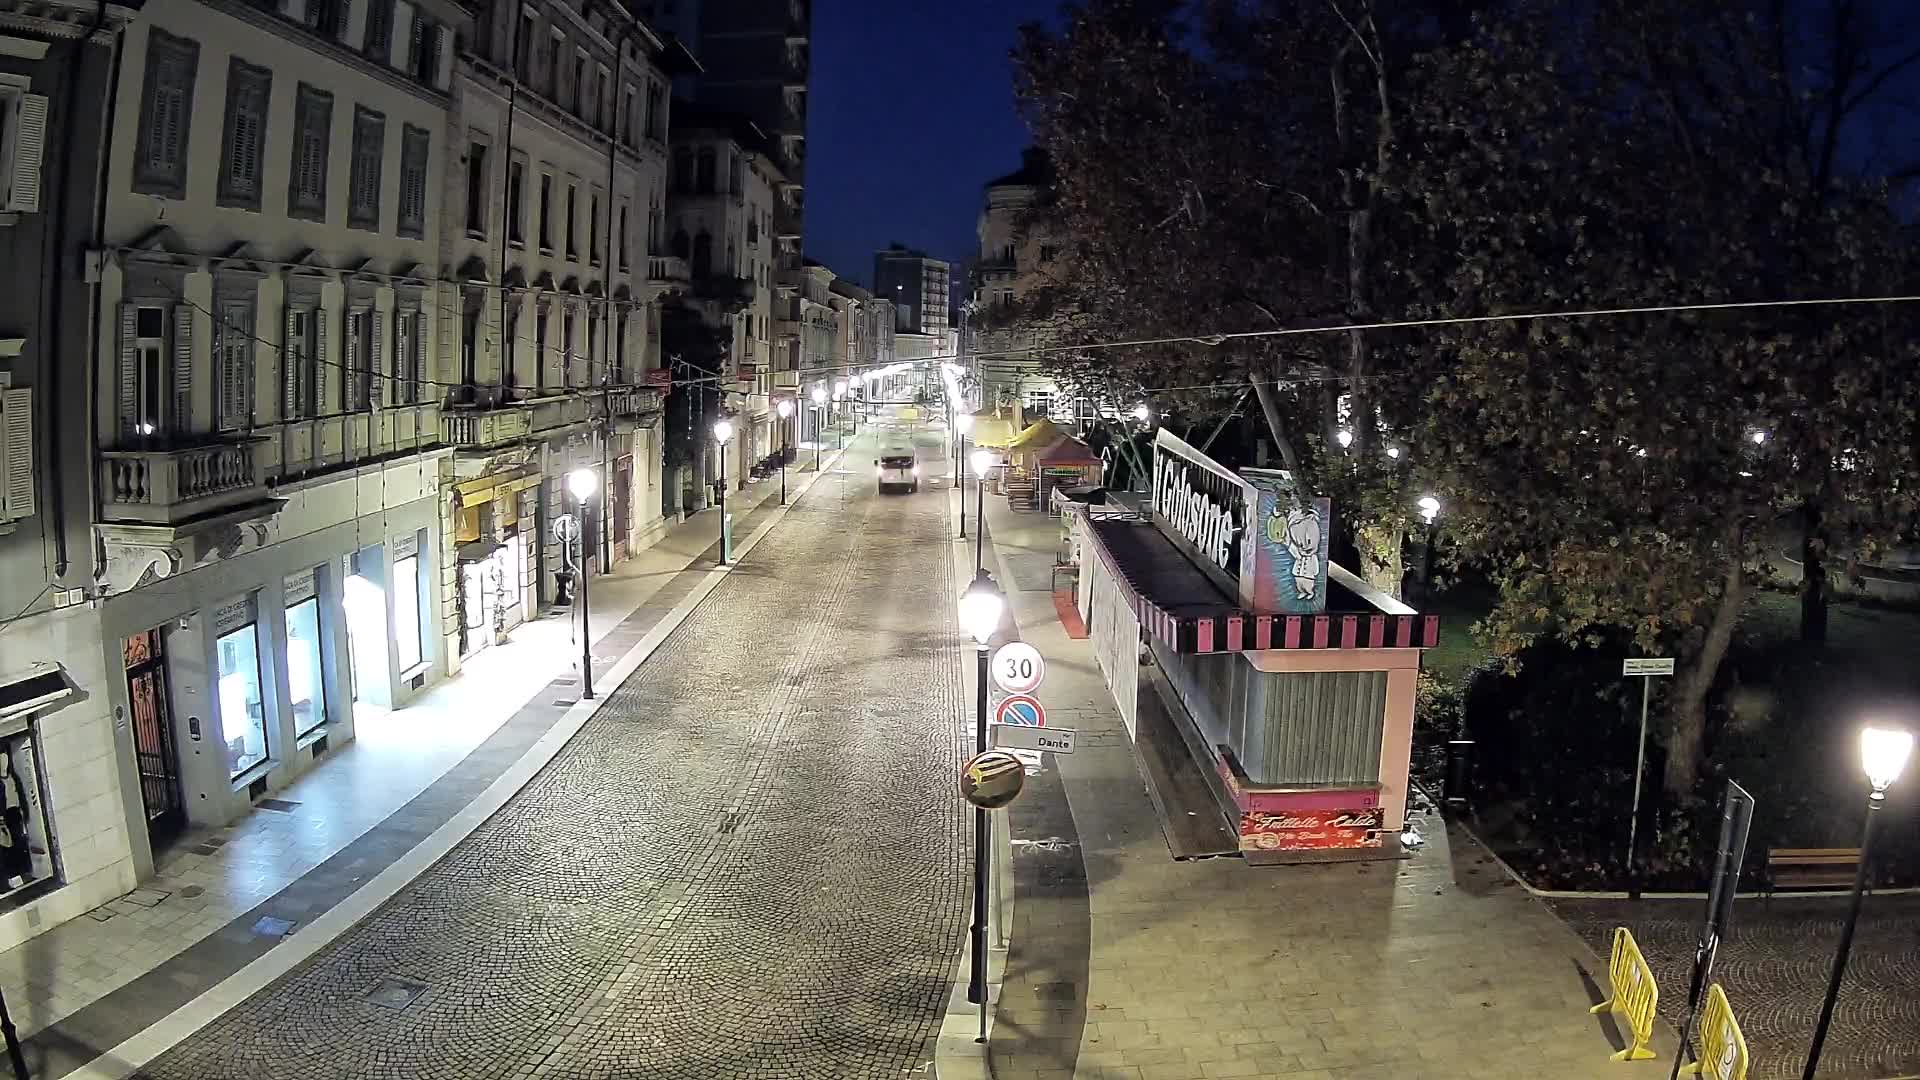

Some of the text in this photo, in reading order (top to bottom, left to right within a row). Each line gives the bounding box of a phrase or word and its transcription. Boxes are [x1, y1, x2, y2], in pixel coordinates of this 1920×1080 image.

[1162, 458, 1233, 568] Golosone
[1006, 658, 1032, 679] 30
[1038, 737, 1070, 749] Dante
